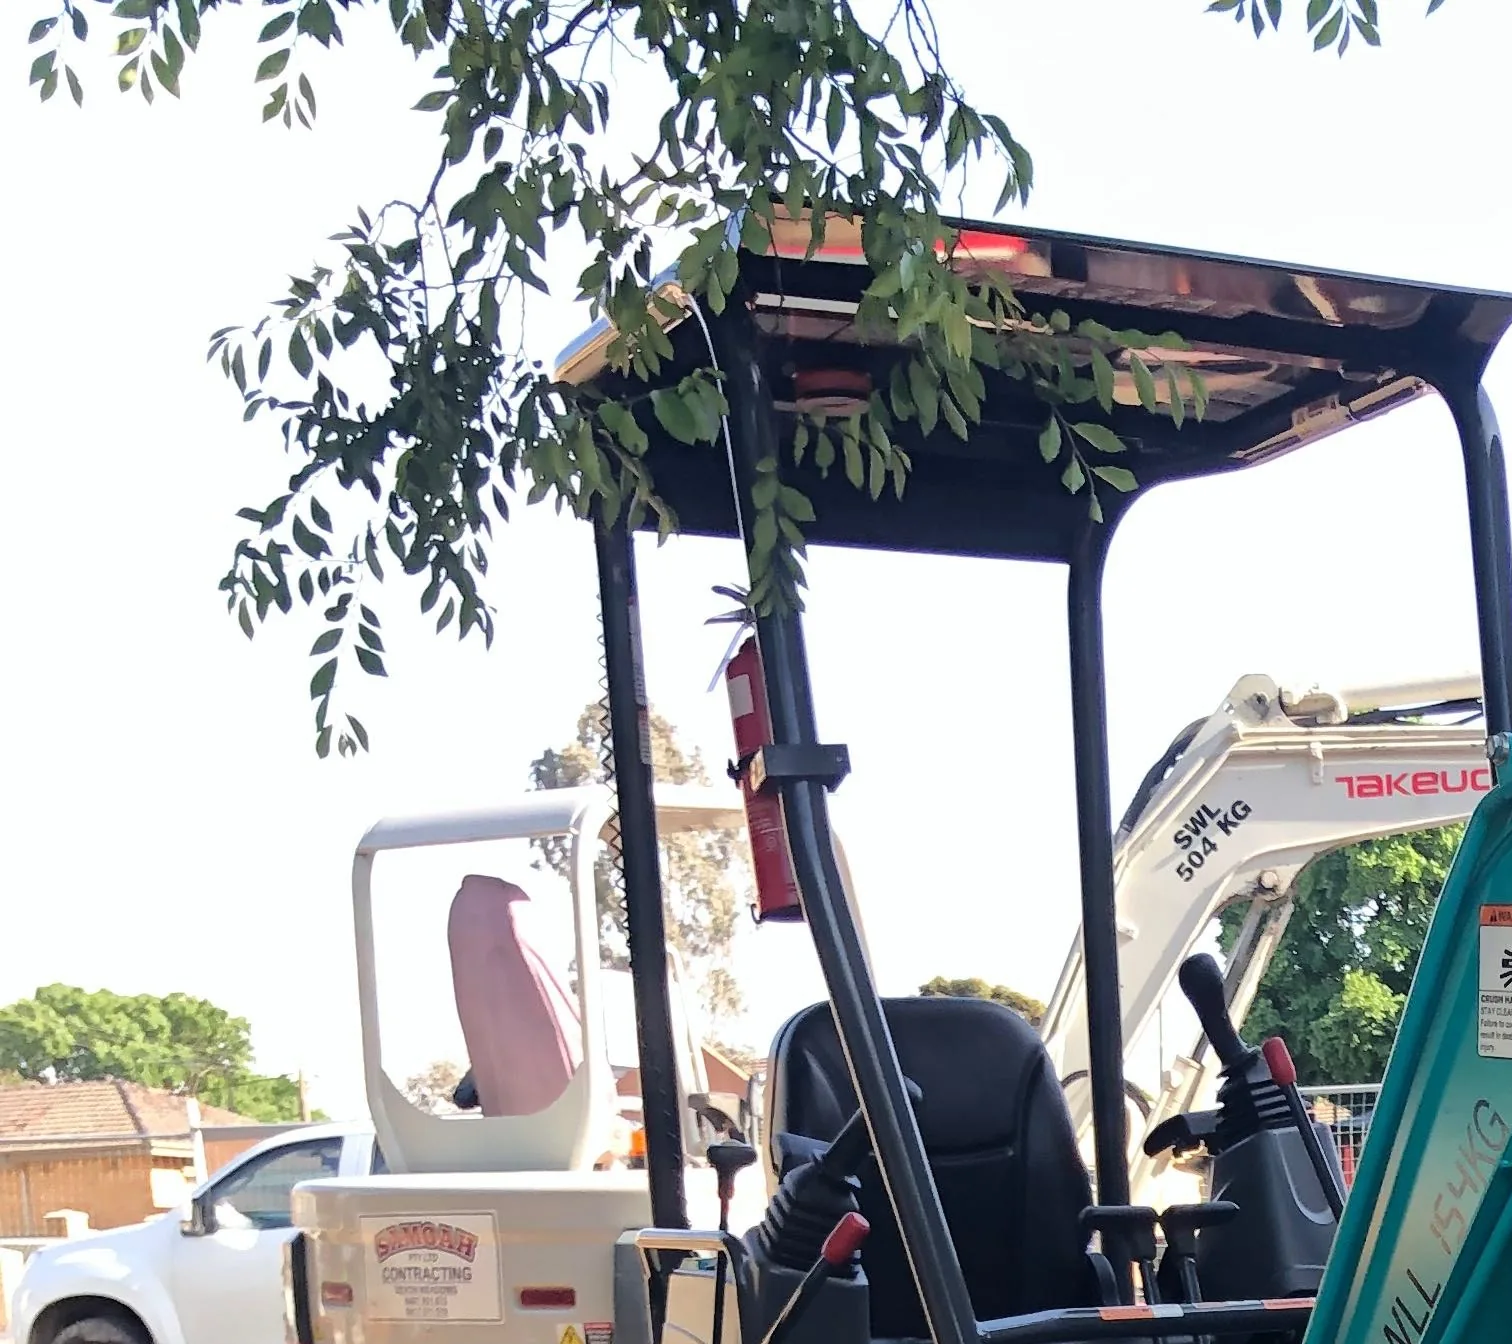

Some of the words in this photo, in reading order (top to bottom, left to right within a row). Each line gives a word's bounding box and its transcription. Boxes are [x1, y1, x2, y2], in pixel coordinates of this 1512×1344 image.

[1335, 768, 1490, 799] TAKEUC
[1173, 799, 1221, 850] SWL
[1175, 836, 1219, 883] 504
[1216, 799, 1253, 837] KG
[382, 1266, 473, 1282] CONTRACTING
